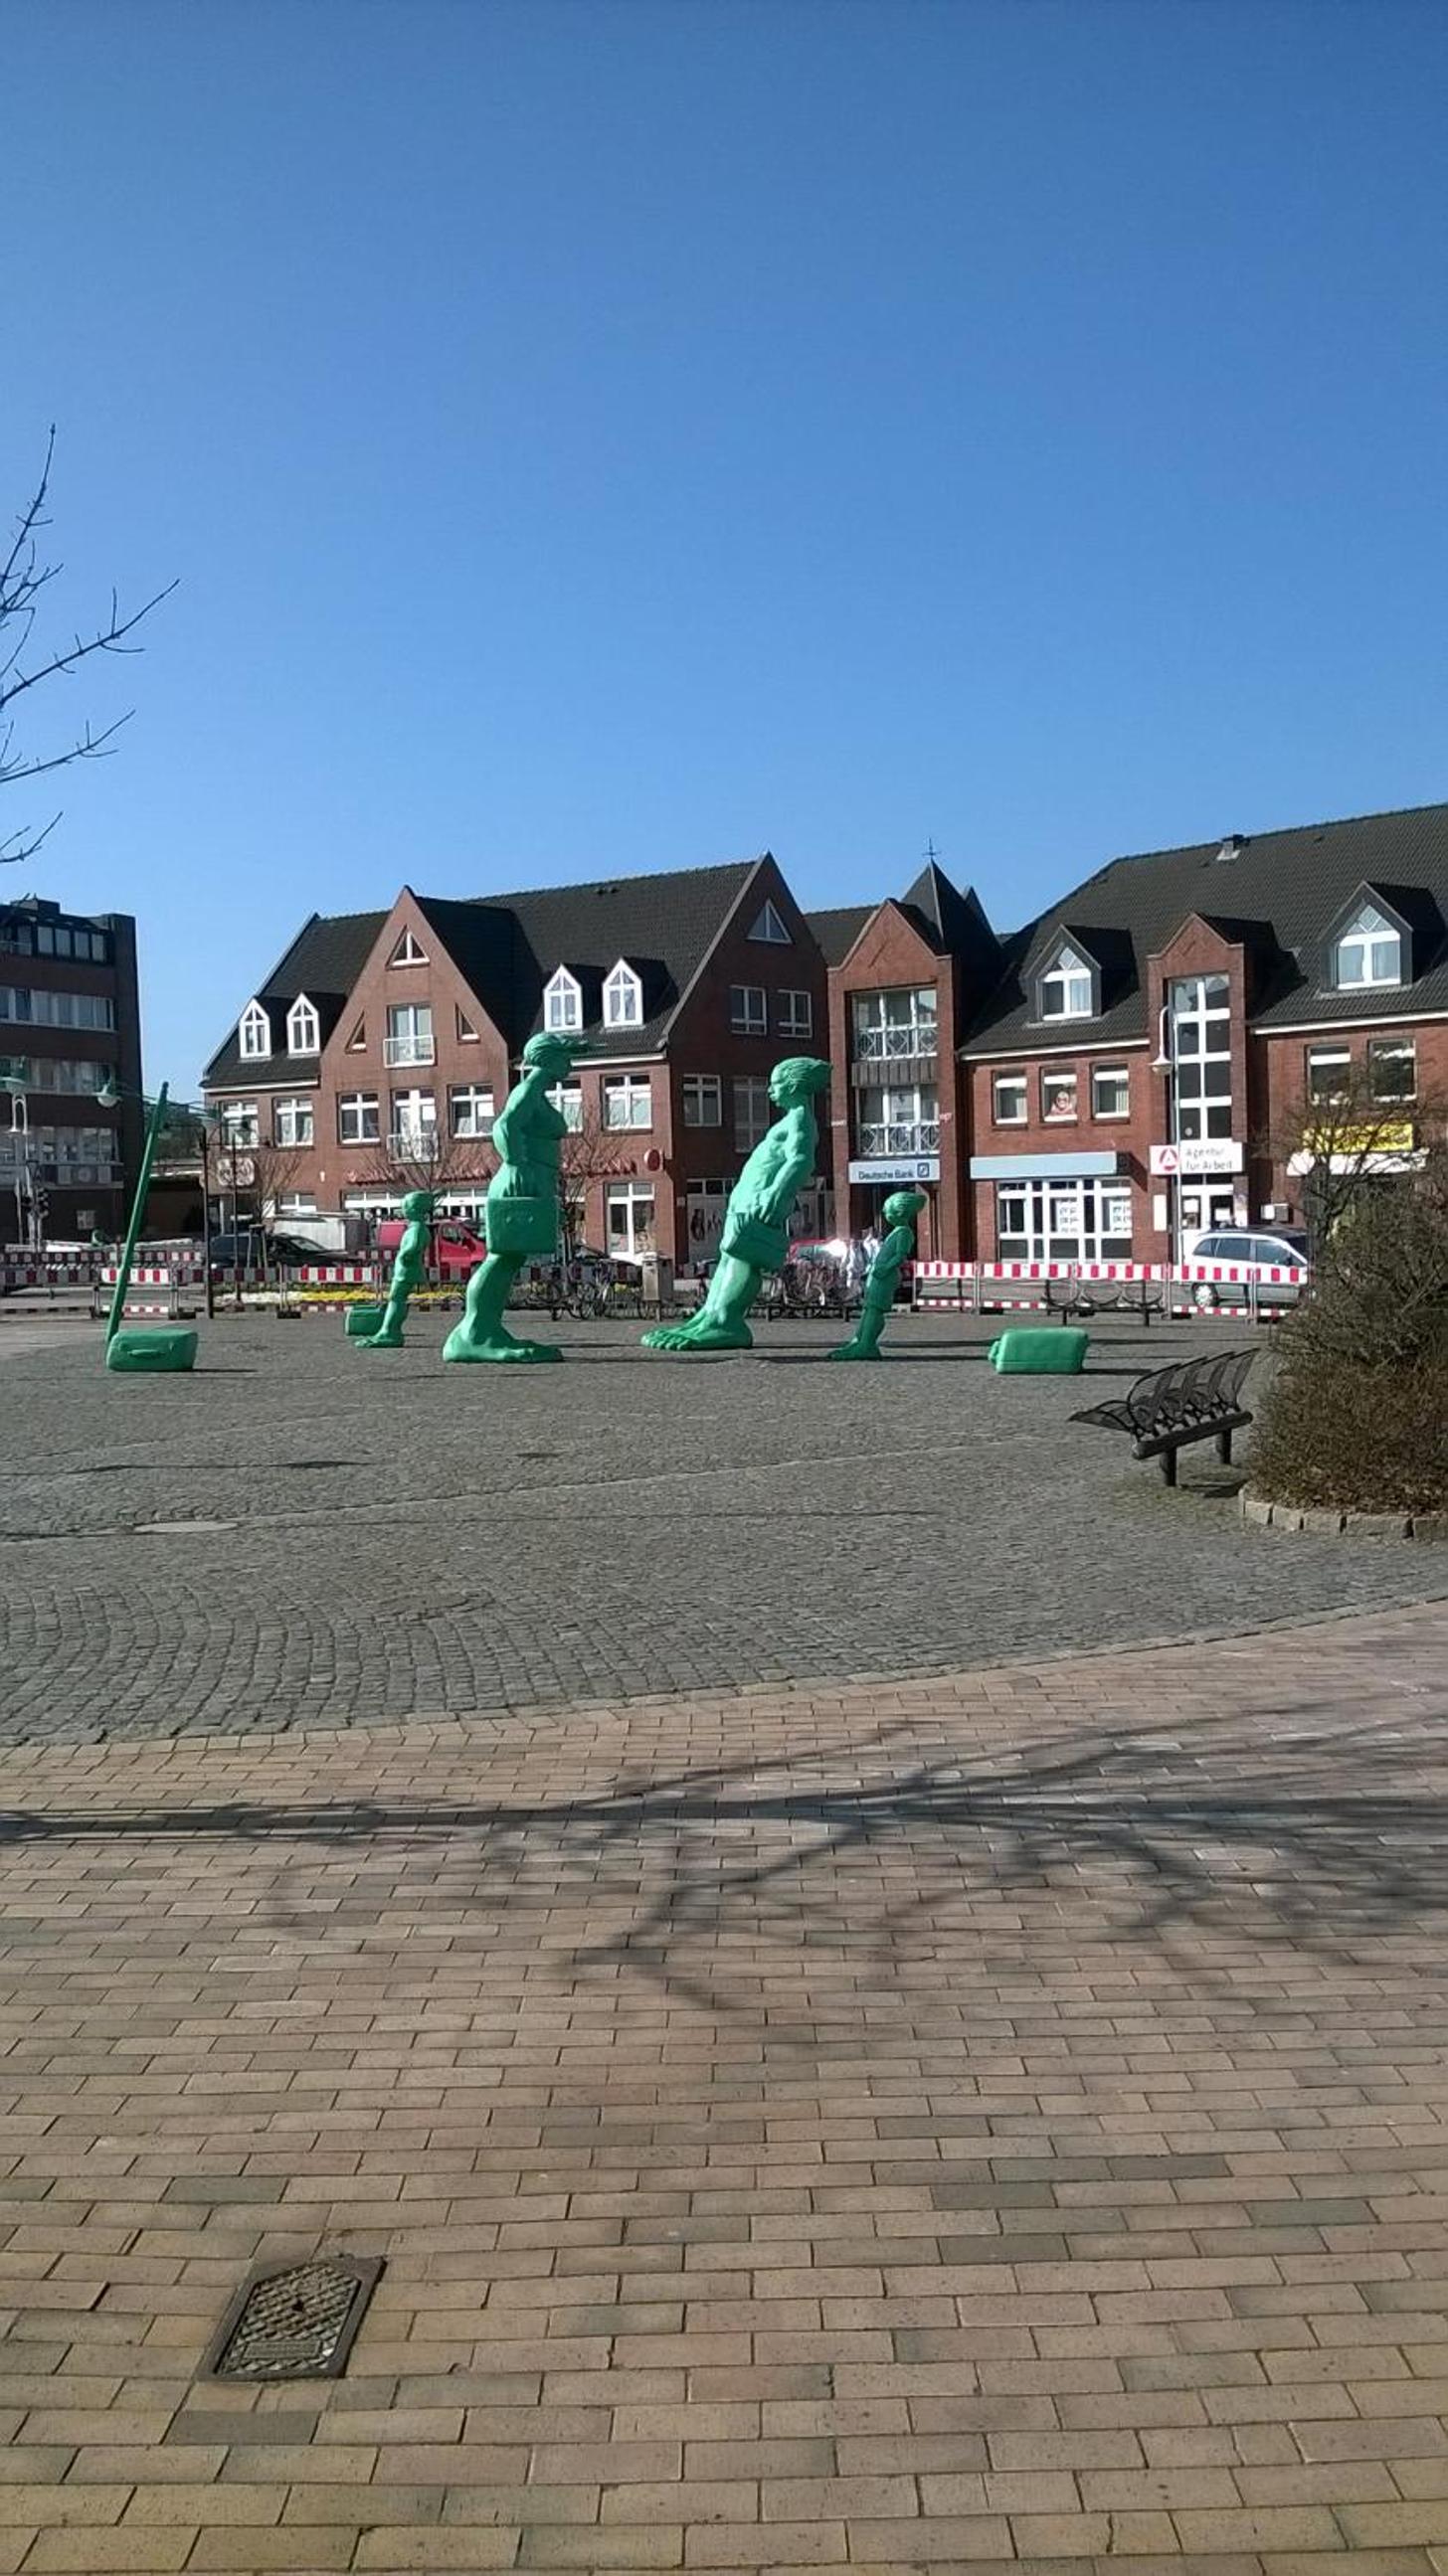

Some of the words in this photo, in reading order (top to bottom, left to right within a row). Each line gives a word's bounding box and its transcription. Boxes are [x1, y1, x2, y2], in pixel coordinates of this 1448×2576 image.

[1185, 1147, 1225, 1159] Agentur
[1202, 1160, 1233, 1170] Arbeit
[858, 1170, 893, 1180] Deutsche
[894, 1169, 915, 1178] Bank
